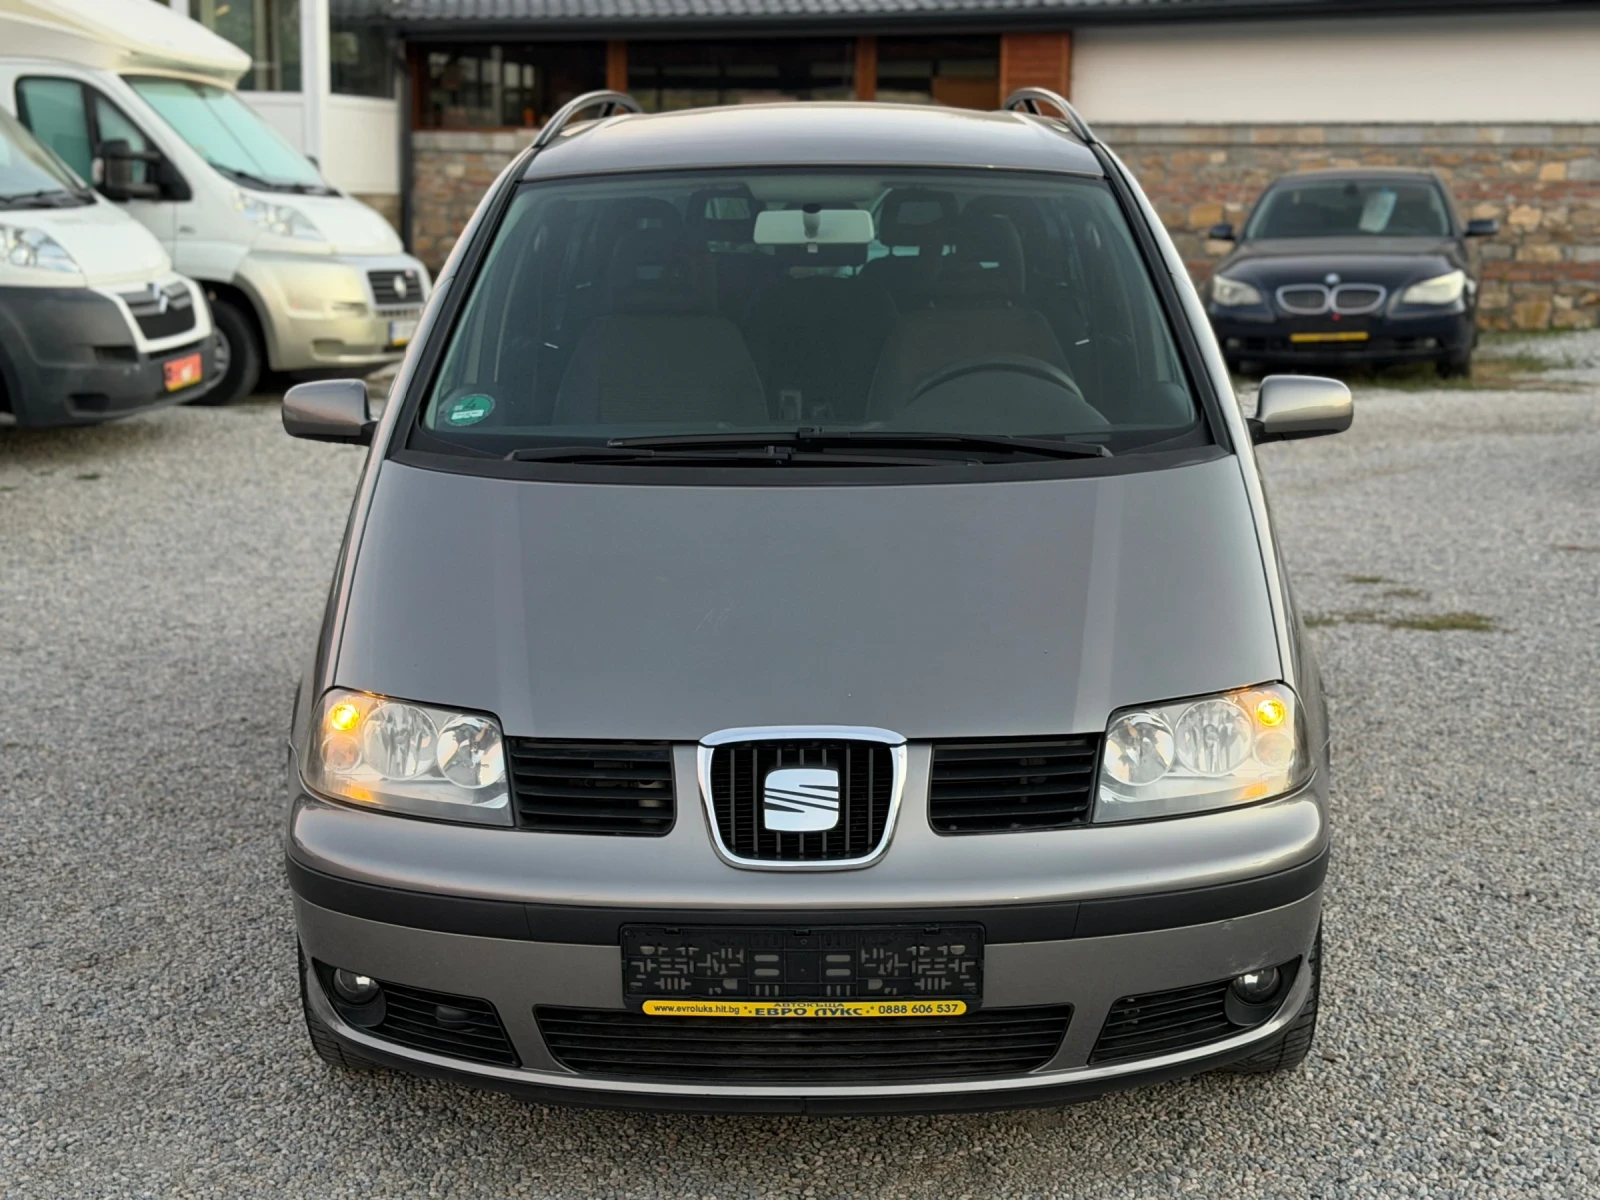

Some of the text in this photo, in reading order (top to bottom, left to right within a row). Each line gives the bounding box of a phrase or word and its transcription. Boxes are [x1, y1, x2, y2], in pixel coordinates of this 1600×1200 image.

[653, 1004, 740, 1015] www.evroluks.hit.bg
[755, 1007, 808, 1017] ЕВРО
[878, 1003, 959, 1015] 0888 606 537
